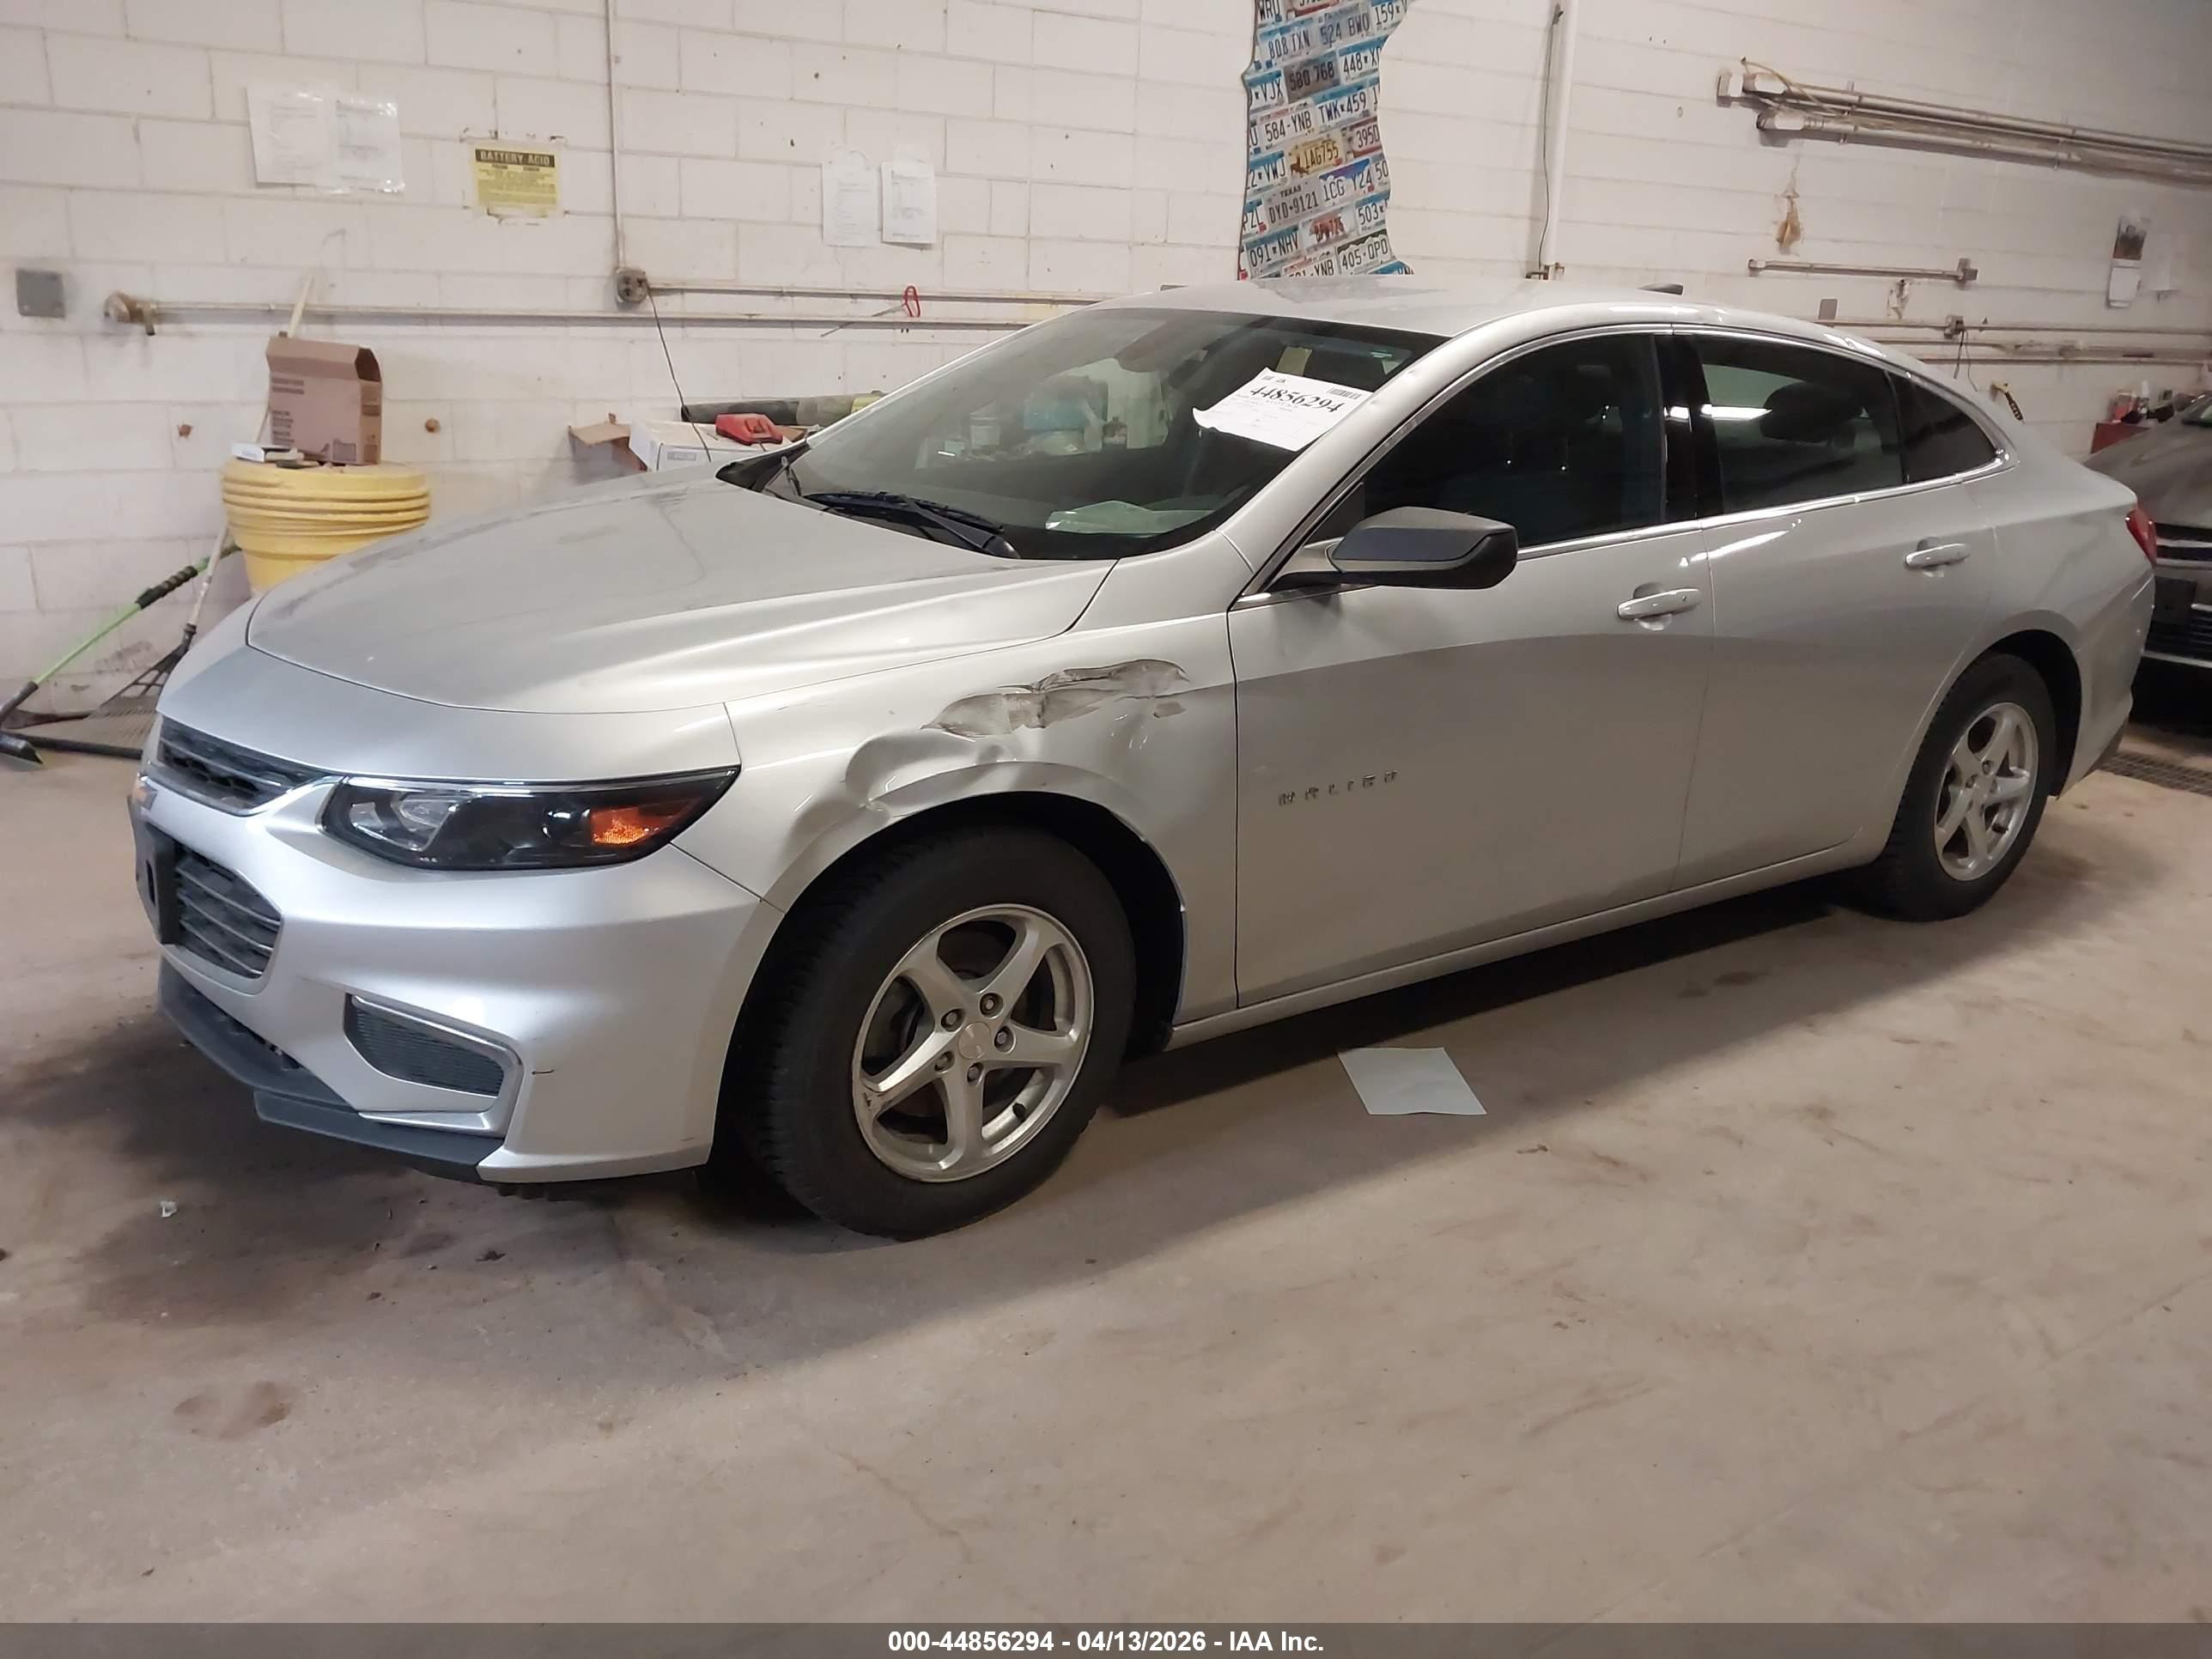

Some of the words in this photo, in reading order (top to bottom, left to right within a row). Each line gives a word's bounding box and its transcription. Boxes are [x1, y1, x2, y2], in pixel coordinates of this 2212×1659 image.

[480, 151, 524, 164] BATTERY
[527, 154, 550, 166] ACID
[1279, 185, 1302, 198] TEXAS
[1250, 386, 1345, 413] 44856294
